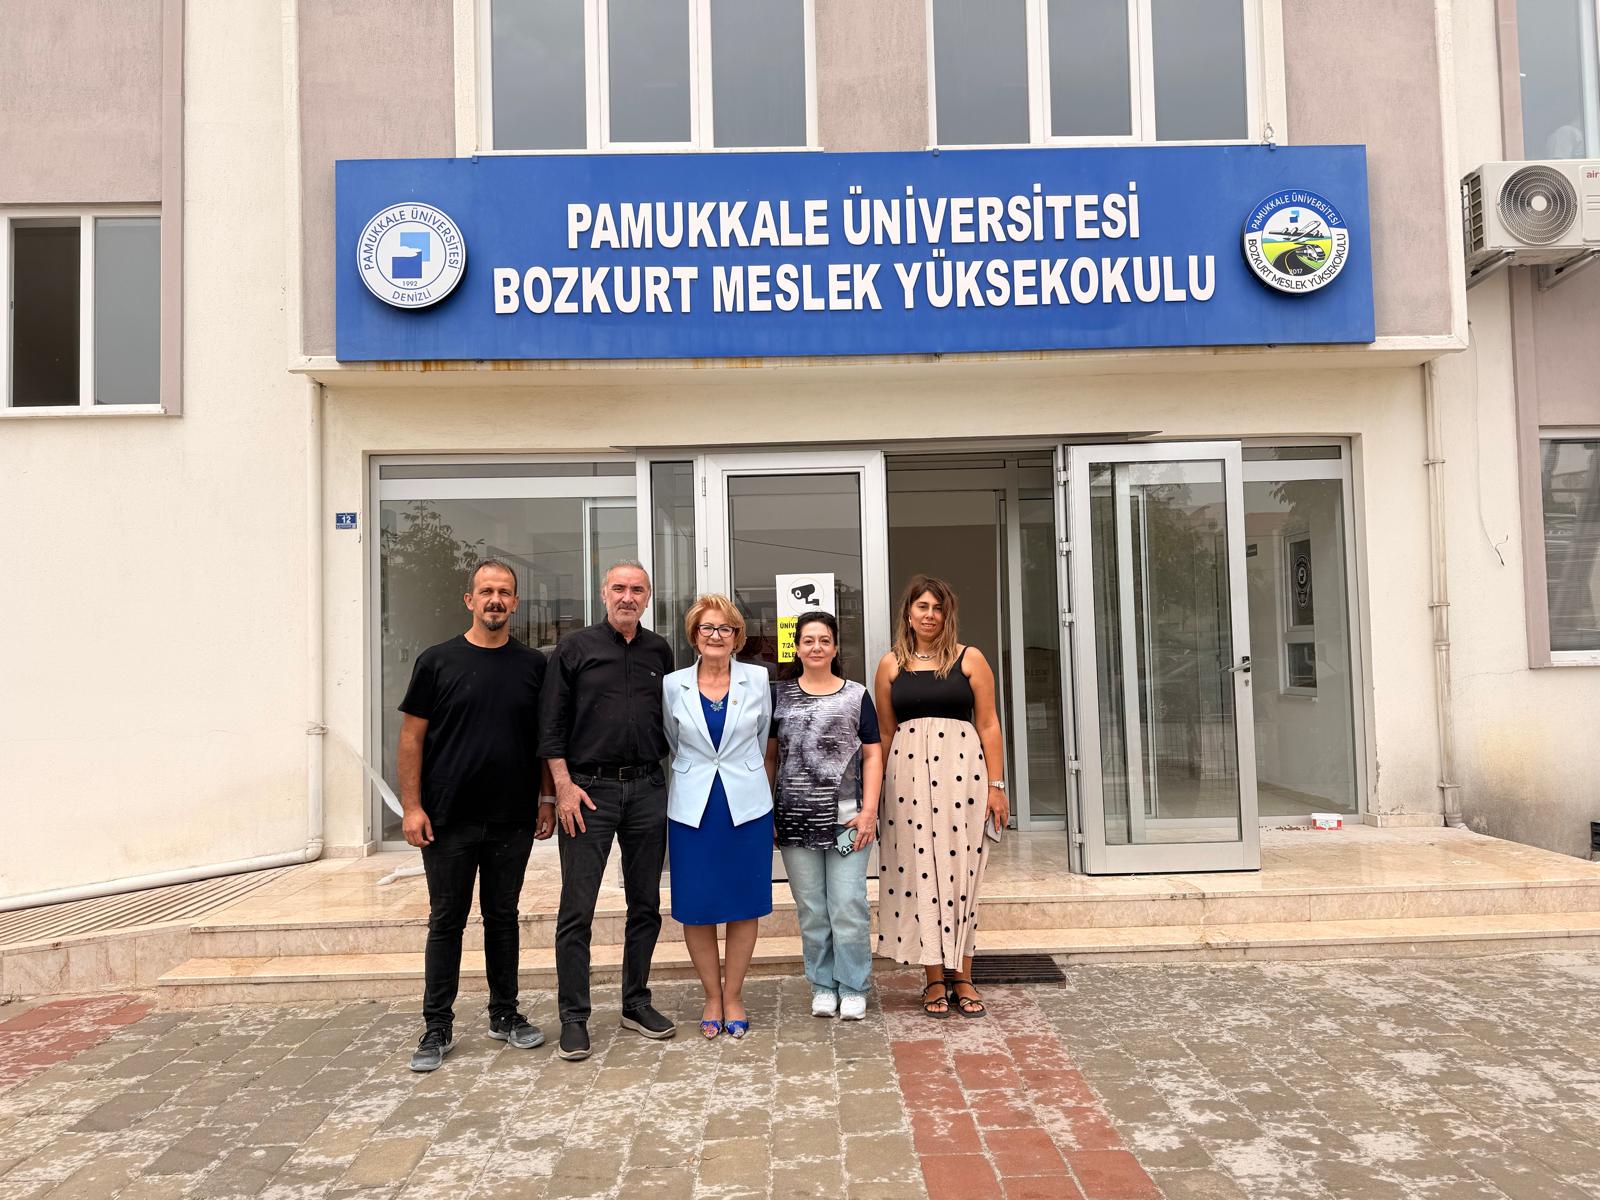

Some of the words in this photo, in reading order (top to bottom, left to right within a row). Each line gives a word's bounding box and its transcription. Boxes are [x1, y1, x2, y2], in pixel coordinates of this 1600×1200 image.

[363, 210, 406, 271] PAMUKKALE
[411, 207, 460, 270] ÜNİVERSİTESİ
[567, 199, 830, 249] PAMUKKALE
[843, 181, 1140, 245] ÜNİVERSİTESİ
[1251, 194, 1290, 230] PAMUKKALE
[1292, 192, 1342, 226] ÜNİVERSİTESİ
[493, 266, 699, 314] BOZKURT
[712, 263, 883, 313] MESLEK
[893, 248, 1216, 309] YÜKSEKOKULU
[1248, 238, 1274, 278] BOZKURT
[1271, 274, 1307, 290] MESLEK
[1307, 233, 1346, 286] YÜKSEKOKULU
[392, 288, 432, 302] DENİZLİ
